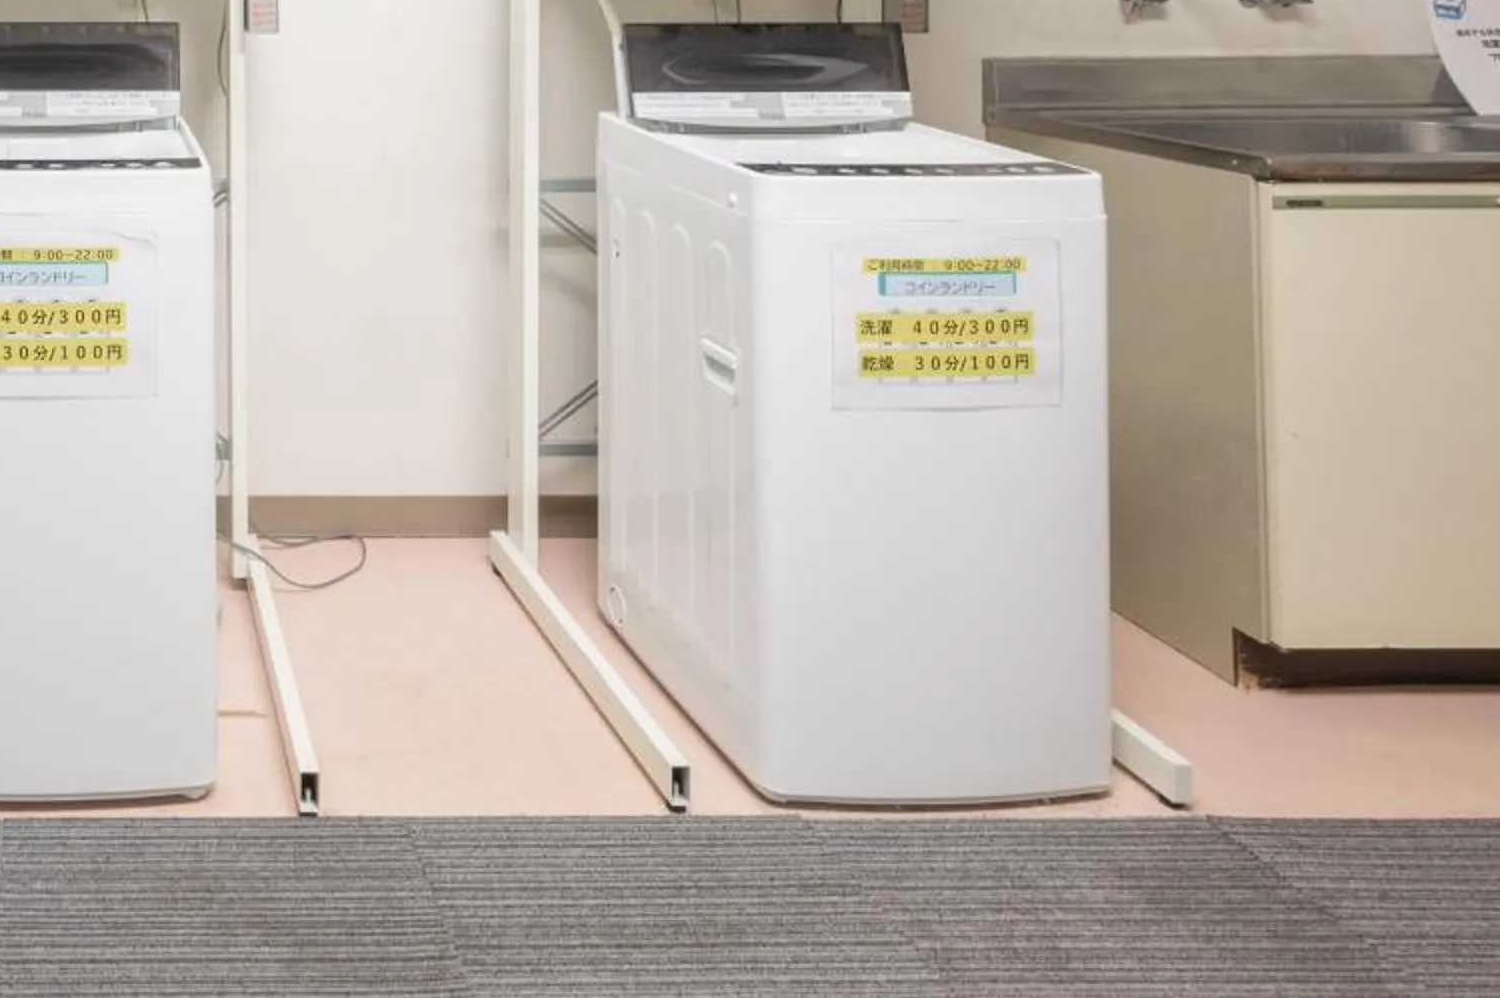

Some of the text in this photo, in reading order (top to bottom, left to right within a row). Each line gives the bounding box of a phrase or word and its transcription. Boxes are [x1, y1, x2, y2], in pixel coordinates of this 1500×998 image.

[904, 280, 997, 296] コインランドリー
[860, 319, 893, 336] 洗濯
[862, 354, 895, 372] 乾燥
